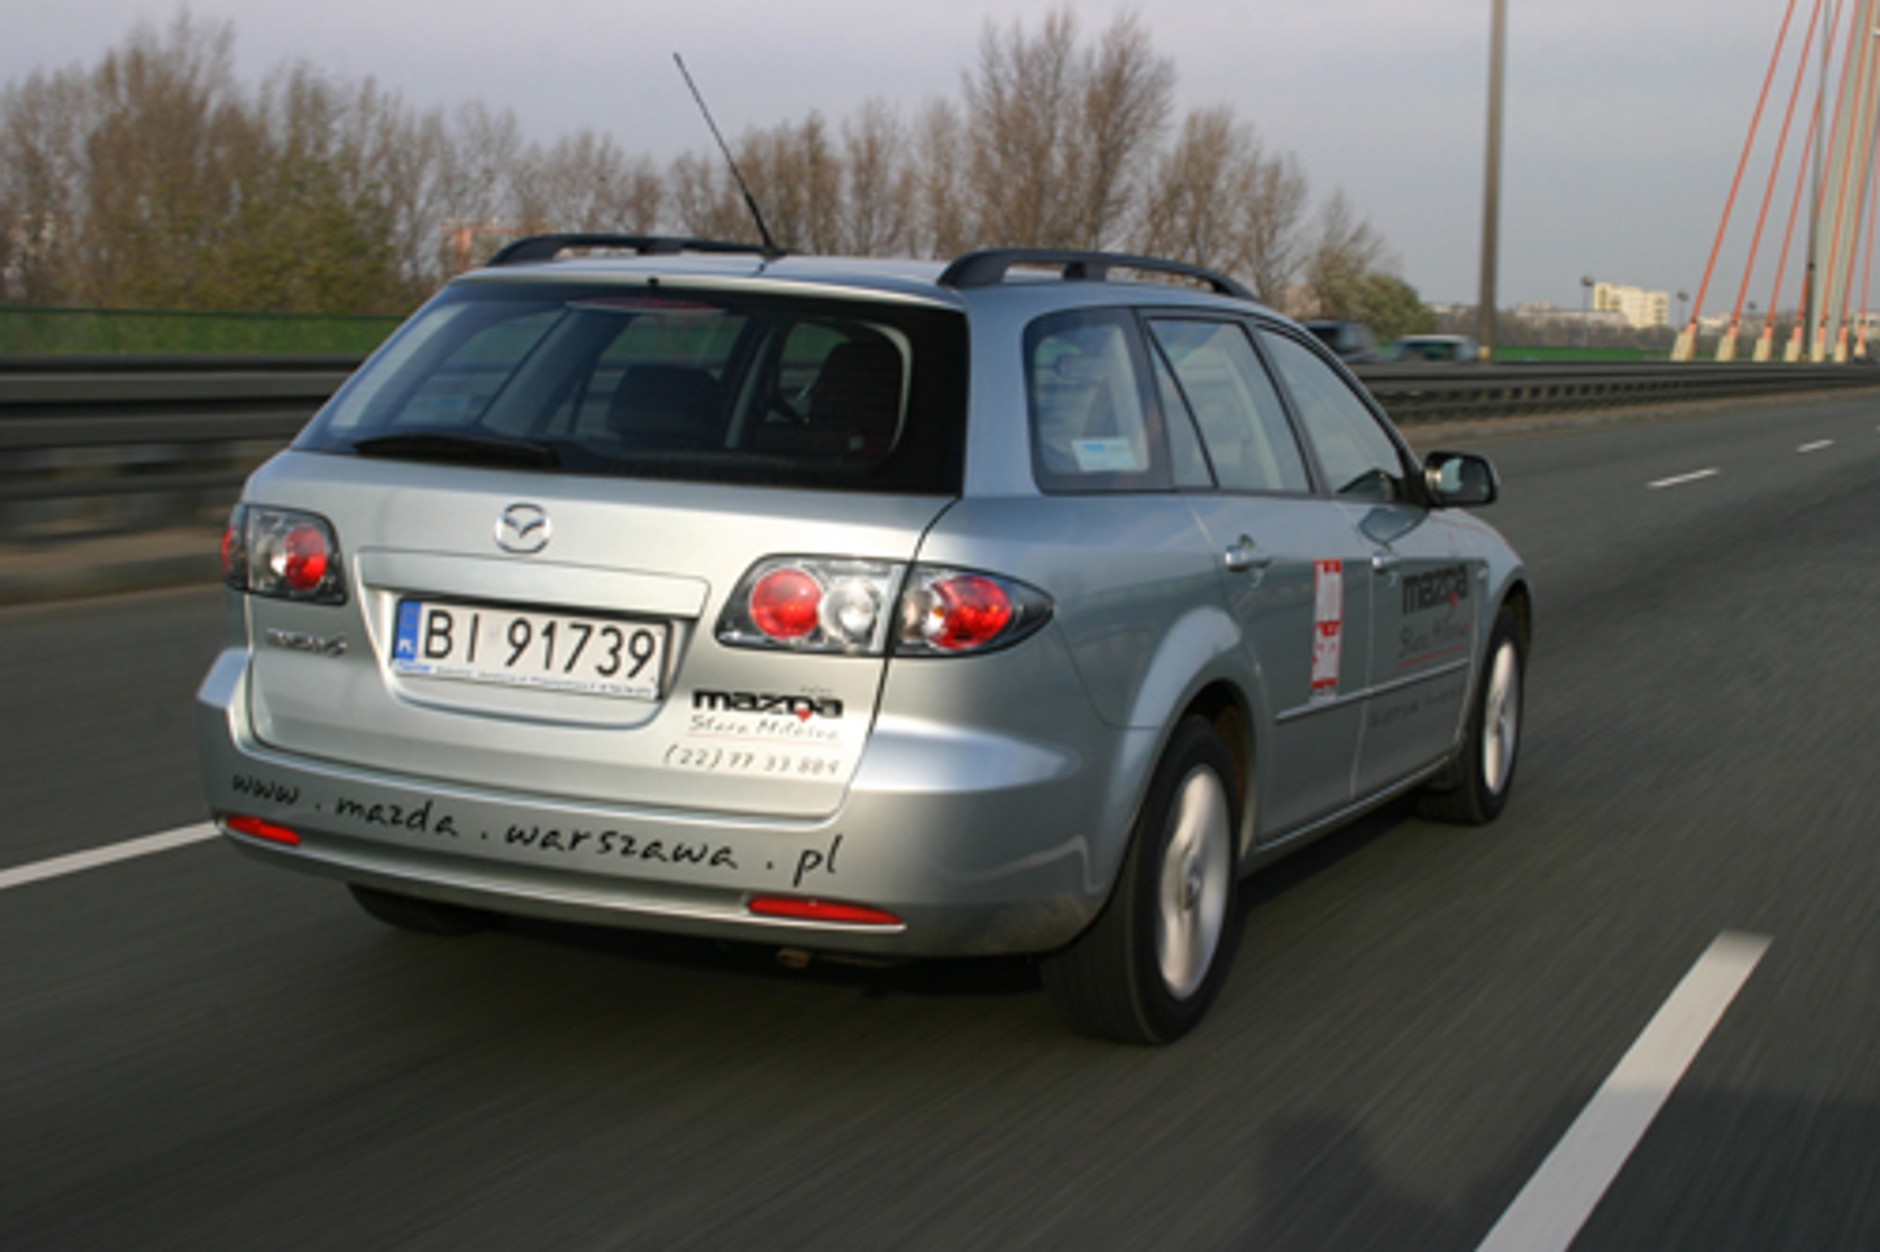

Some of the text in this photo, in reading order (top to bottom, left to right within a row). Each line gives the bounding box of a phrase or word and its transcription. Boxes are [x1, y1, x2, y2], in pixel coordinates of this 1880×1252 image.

[424, 608, 479, 663] BI
[504, 617, 656, 680] 91739
[692, 690, 844, 721] mazda
[335, 797, 459, 838] mazda
[505, 823, 738, 870] warszawa
[793, 833, 843, 888] pl
